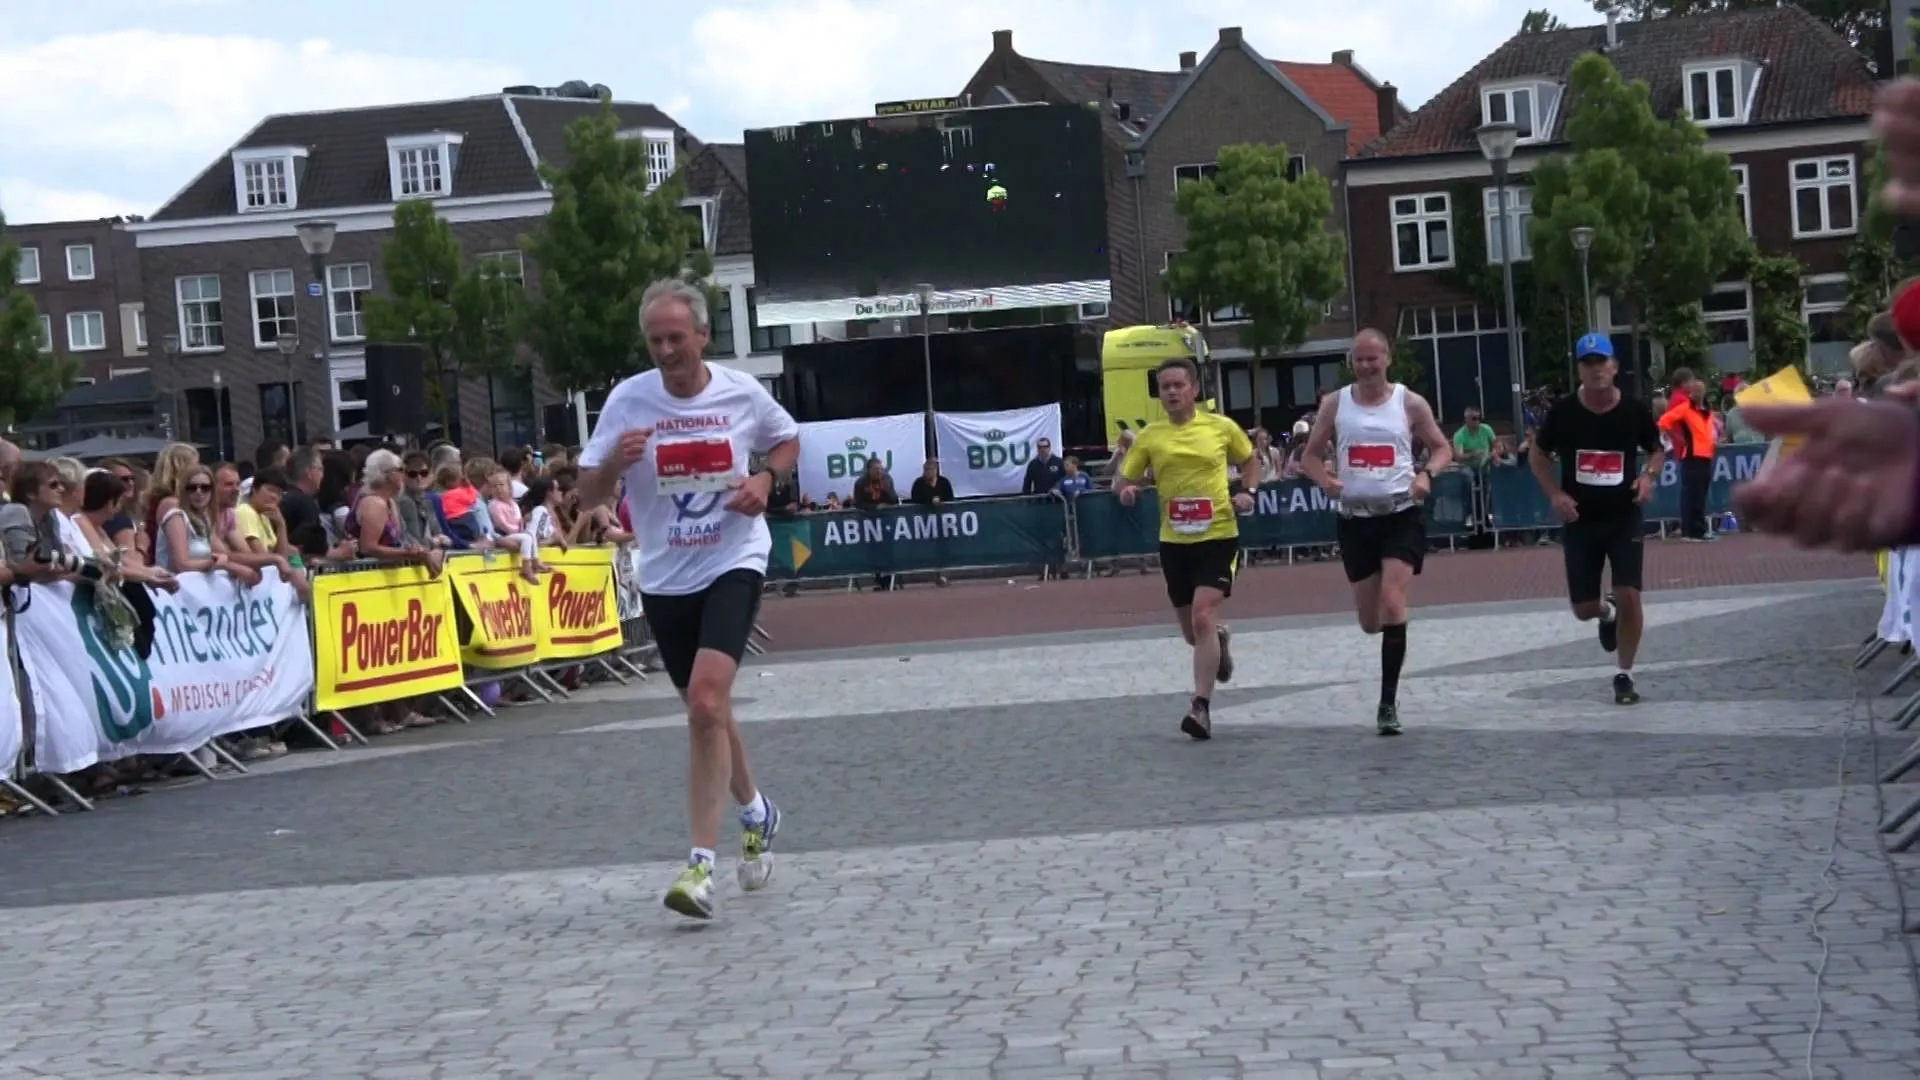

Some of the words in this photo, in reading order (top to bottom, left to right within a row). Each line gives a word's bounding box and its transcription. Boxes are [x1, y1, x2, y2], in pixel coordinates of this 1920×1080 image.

[656, 416, 729, 431] NATIONALE
[967, 441, 1031, 470] BDU
[668, 526, 682, 537] 70
[342, 598, 443, 674] PowerBar
[171, 682, 231, 713] MEDISCH
